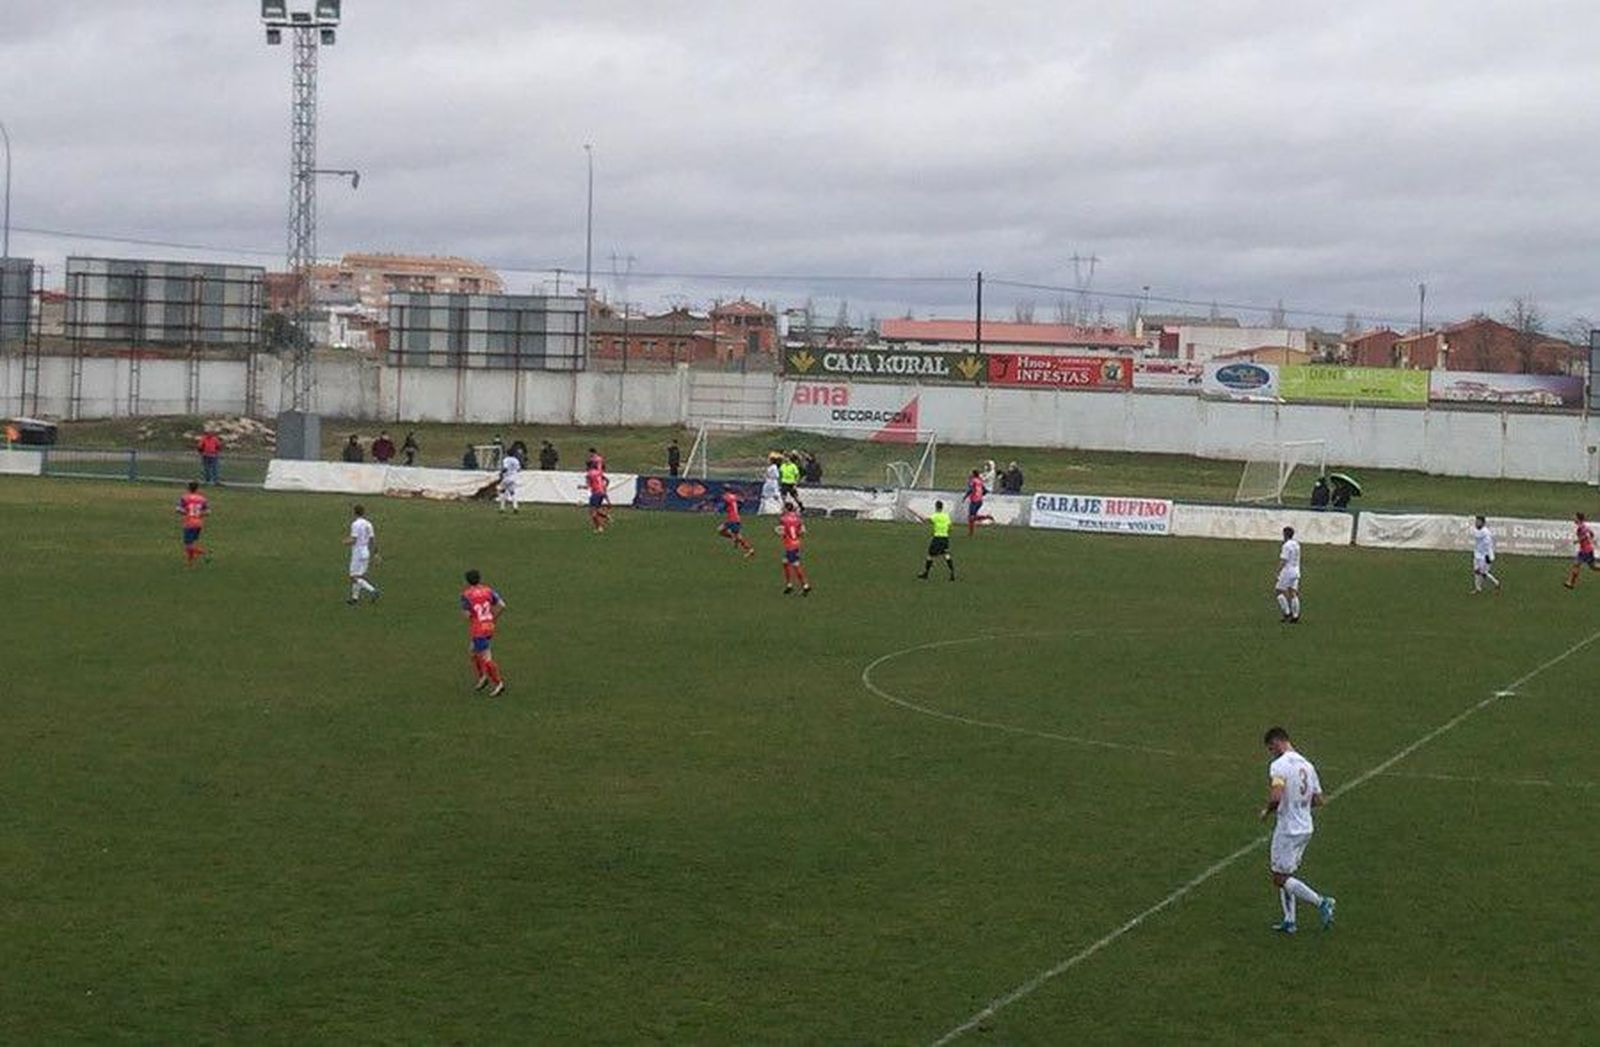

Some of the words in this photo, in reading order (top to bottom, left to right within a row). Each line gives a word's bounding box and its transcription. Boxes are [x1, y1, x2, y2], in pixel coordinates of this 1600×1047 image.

[823, 352, 876, 373] CAJA
[877, 354, 949, 375] RURAL
[1017, 369, 1091, 384] INFESTAS
[795, 384, 849, 406] ana
[1036, 495, 1101, 514] GARAJE
[1105, 500, 1168, 517] RUFINO
[1299, 767, 1308, 796] 3
